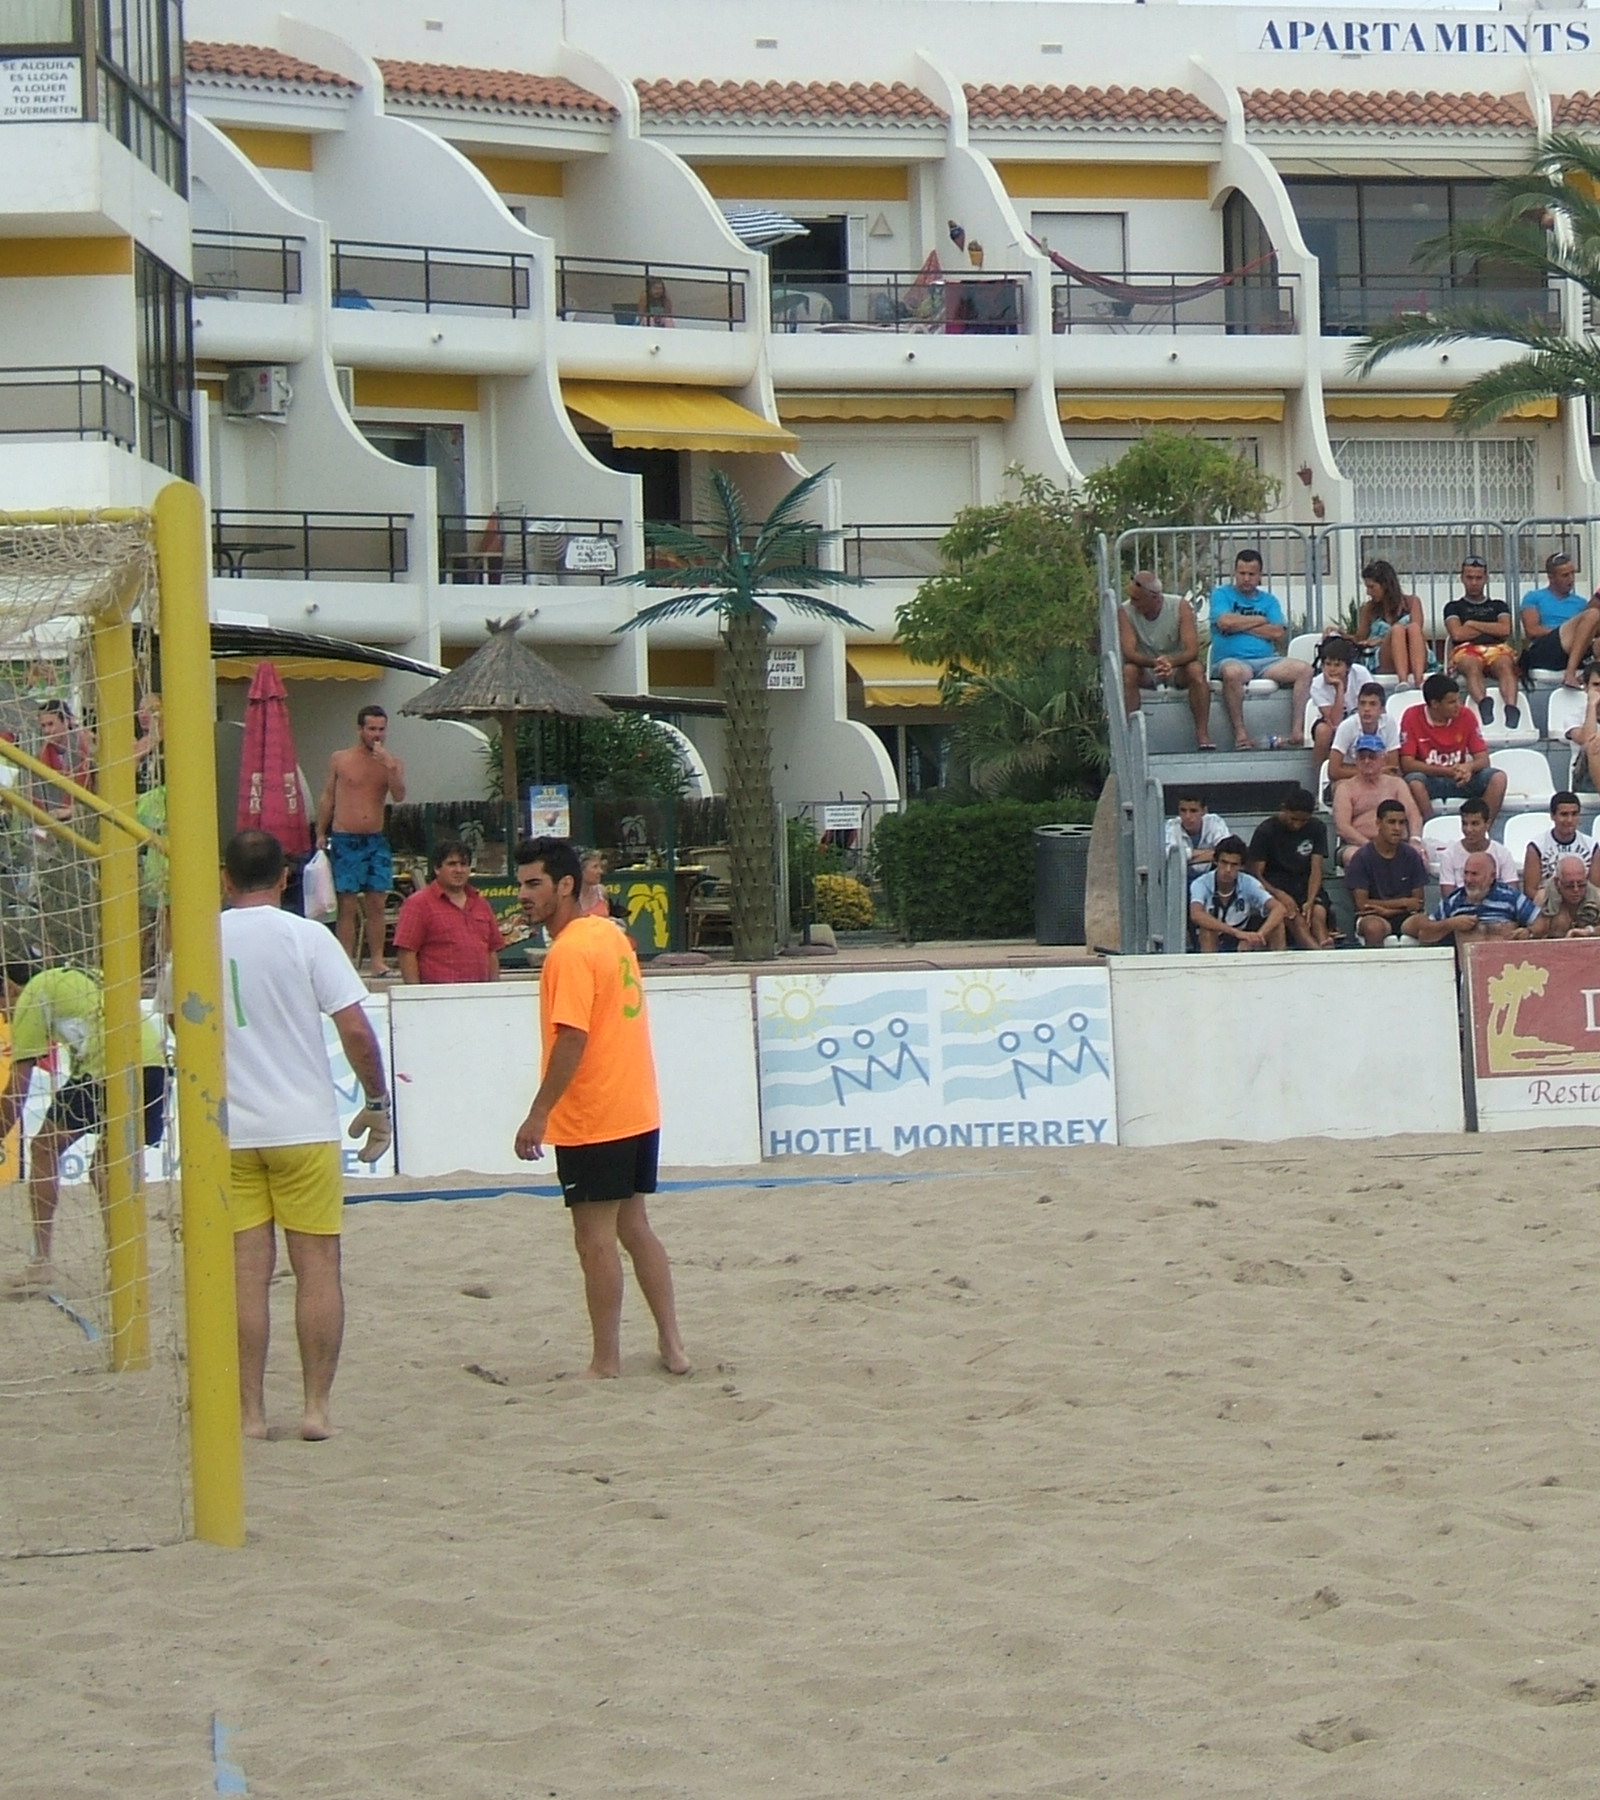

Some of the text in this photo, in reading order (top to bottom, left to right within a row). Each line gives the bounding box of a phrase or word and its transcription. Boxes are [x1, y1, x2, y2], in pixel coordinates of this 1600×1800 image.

[1258, 20, 1590, 53] APARTAMENTS
[2, 61, 75, 71] SE ALQUILA
[10, 72, 69, 82] ES LLOGA
[12, 83, 66, 93] A LOUER
[14, 94, 65, 104] TO RENT
[4, 105, 78, 115] ZU VERMIETEN
[774, 651, 797, 661] LLOGA
[619, 955, 643, 1019] 3
[229, 957, 247, 1028] 1
[770, 1118, 1108, 1156] HOTEL MONTERREY
